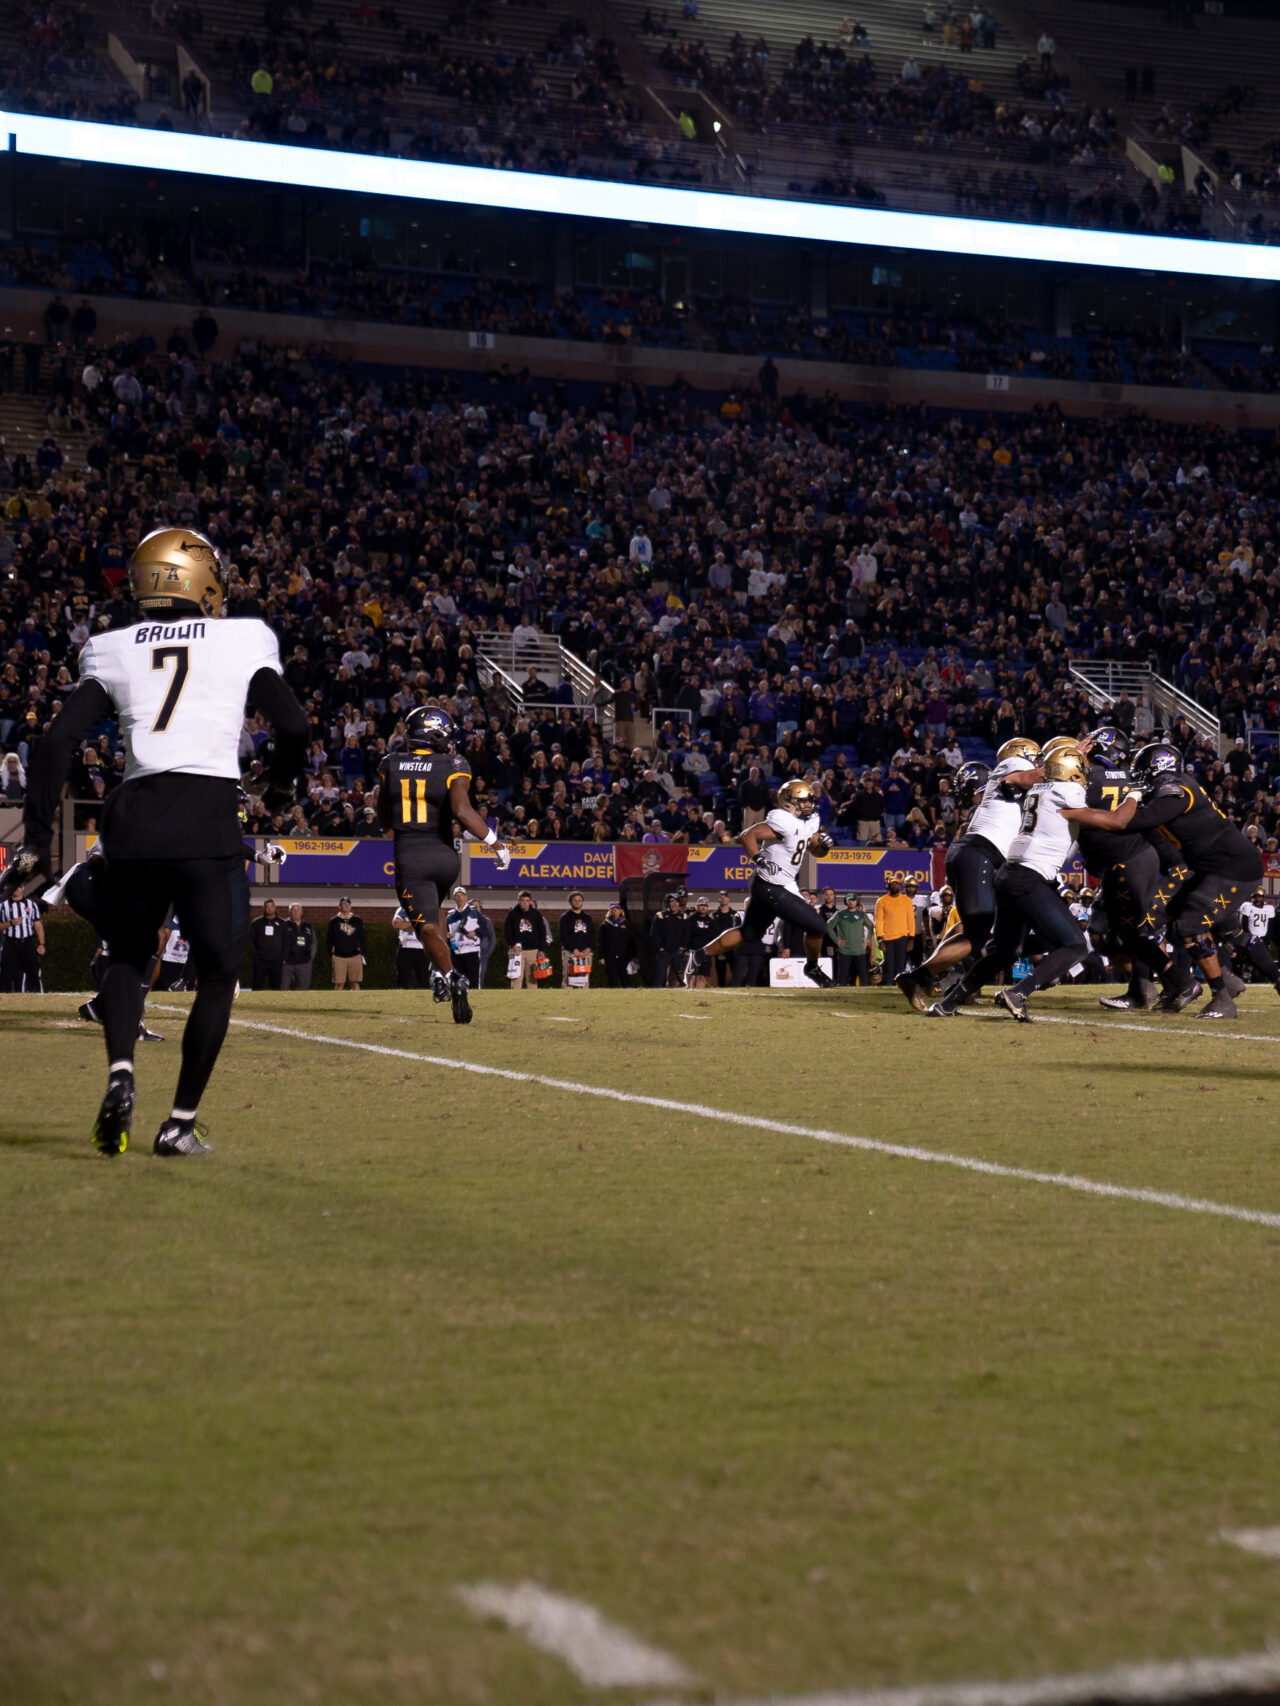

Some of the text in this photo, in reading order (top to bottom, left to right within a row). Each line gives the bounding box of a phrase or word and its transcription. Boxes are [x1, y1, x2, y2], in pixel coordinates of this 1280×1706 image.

[476, 334, 488, 347] 16
[993, 377, 1003, 388] 17
[134, 622, 206, 644] BROWN
[150, 643, 191, 735] 7
[399, 761, 433, 772] WINSTEAD
[399, 778, 428, 824] 11
[294, 841, 344, 851] 1962-1964
[829, 852, 872, 860] 1973-1976
[1253, 913, 1267, 928] 24
